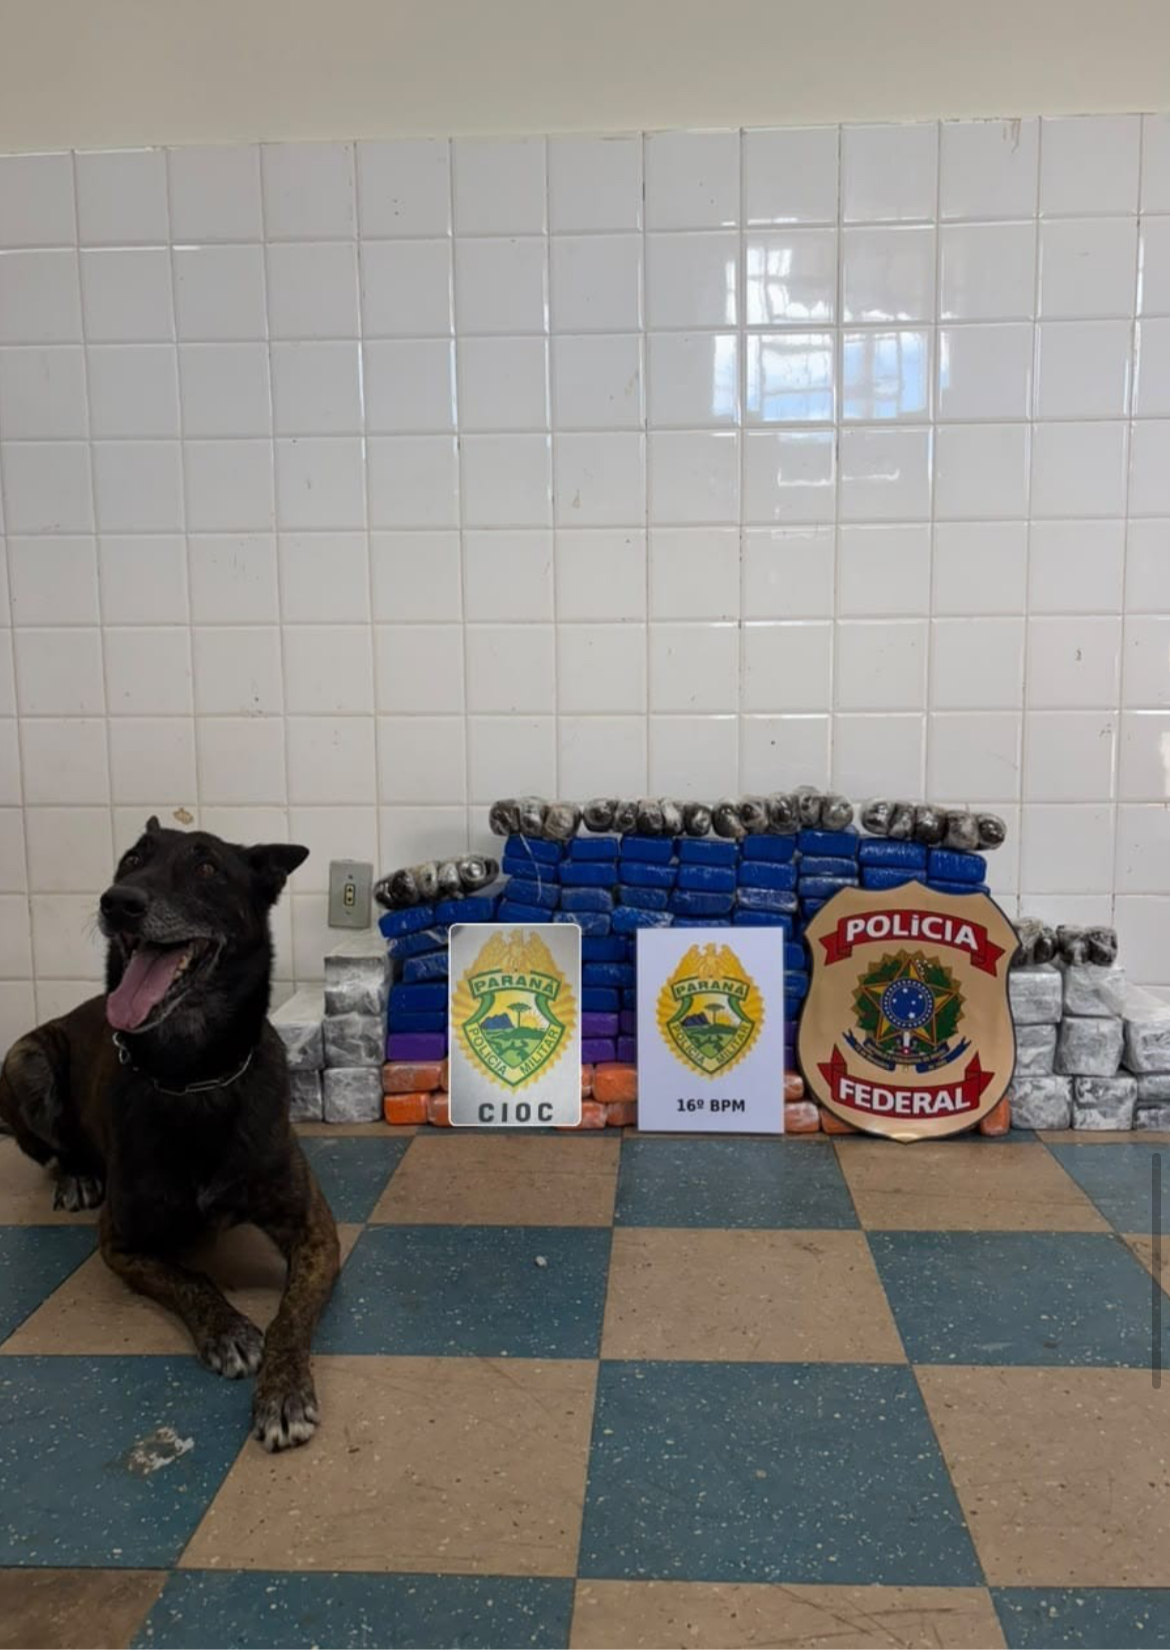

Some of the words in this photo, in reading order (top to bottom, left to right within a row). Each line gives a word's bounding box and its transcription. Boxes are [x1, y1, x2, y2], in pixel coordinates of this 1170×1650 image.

[520, 1029, 559, 1074] MILITAR
[716, 1024, 750, 1064] MILITAR
[478, 1102, 553, 1122] CIOC
[710, 1099, 746, 1112] BPM
[839, 1078, 970, 1114] FEDERAL
